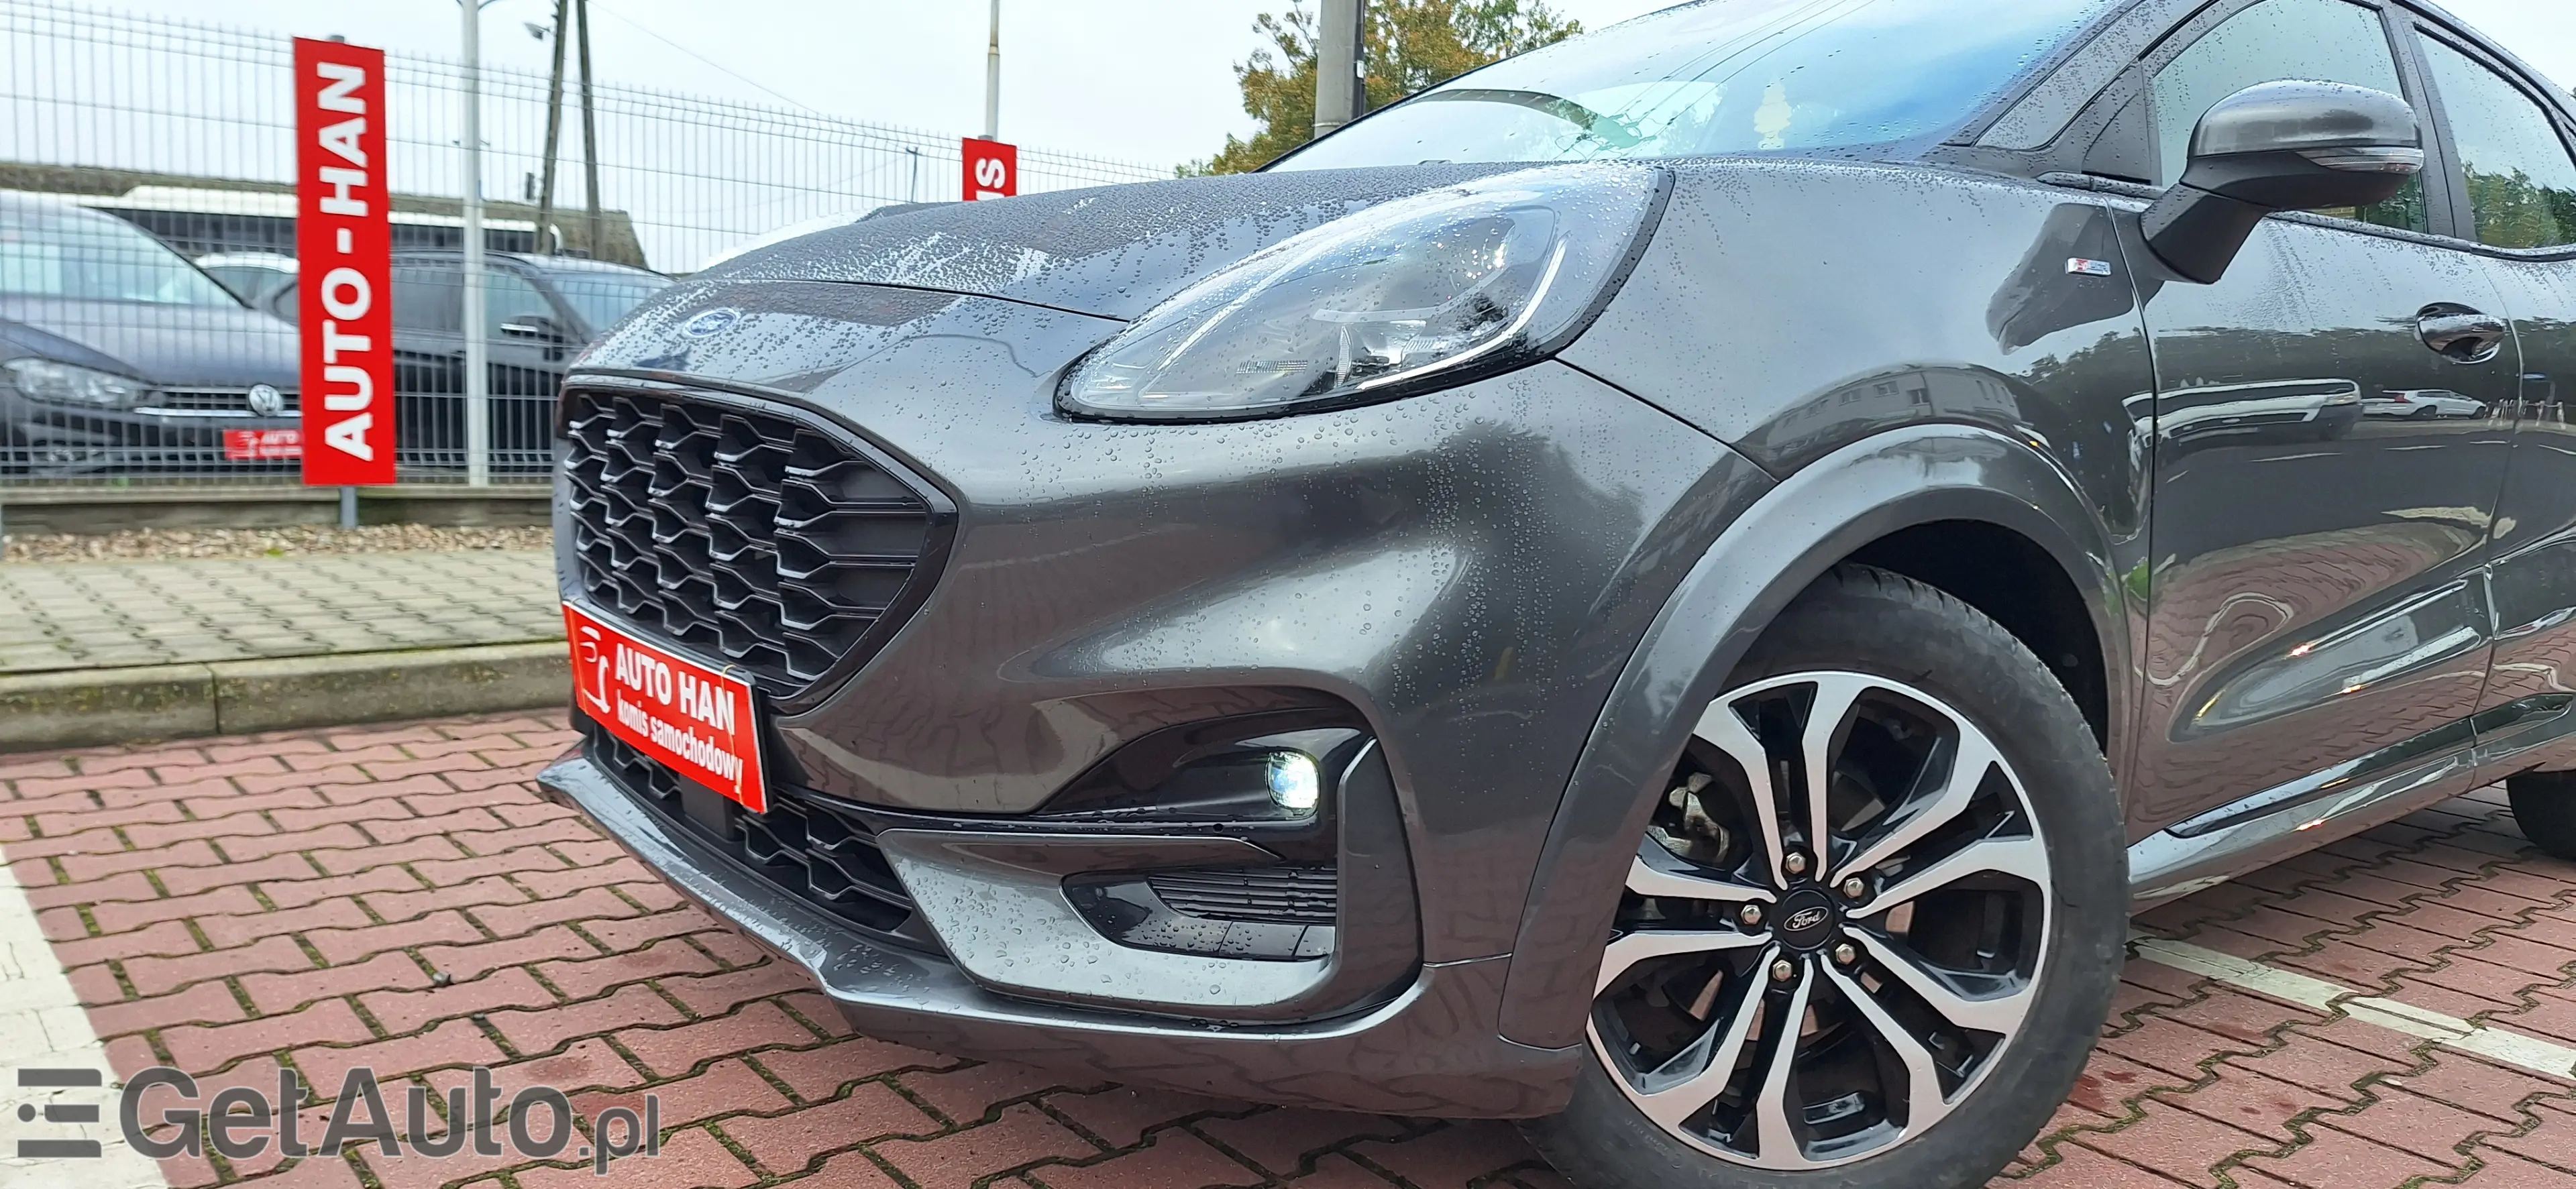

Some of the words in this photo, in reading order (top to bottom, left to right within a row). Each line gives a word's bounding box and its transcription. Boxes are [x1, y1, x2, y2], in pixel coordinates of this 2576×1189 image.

[317, 61, 368, 217] HAN
[321, 267, 374, 462] AUTO
[615, 642, 672, 705] AUTO
[678, 671, 735, 736] HAN
[617, 689, 649, 737] komis
[650, 716, 743, 794] samochodowy
[1792, 911, 1821, 929] Ford
